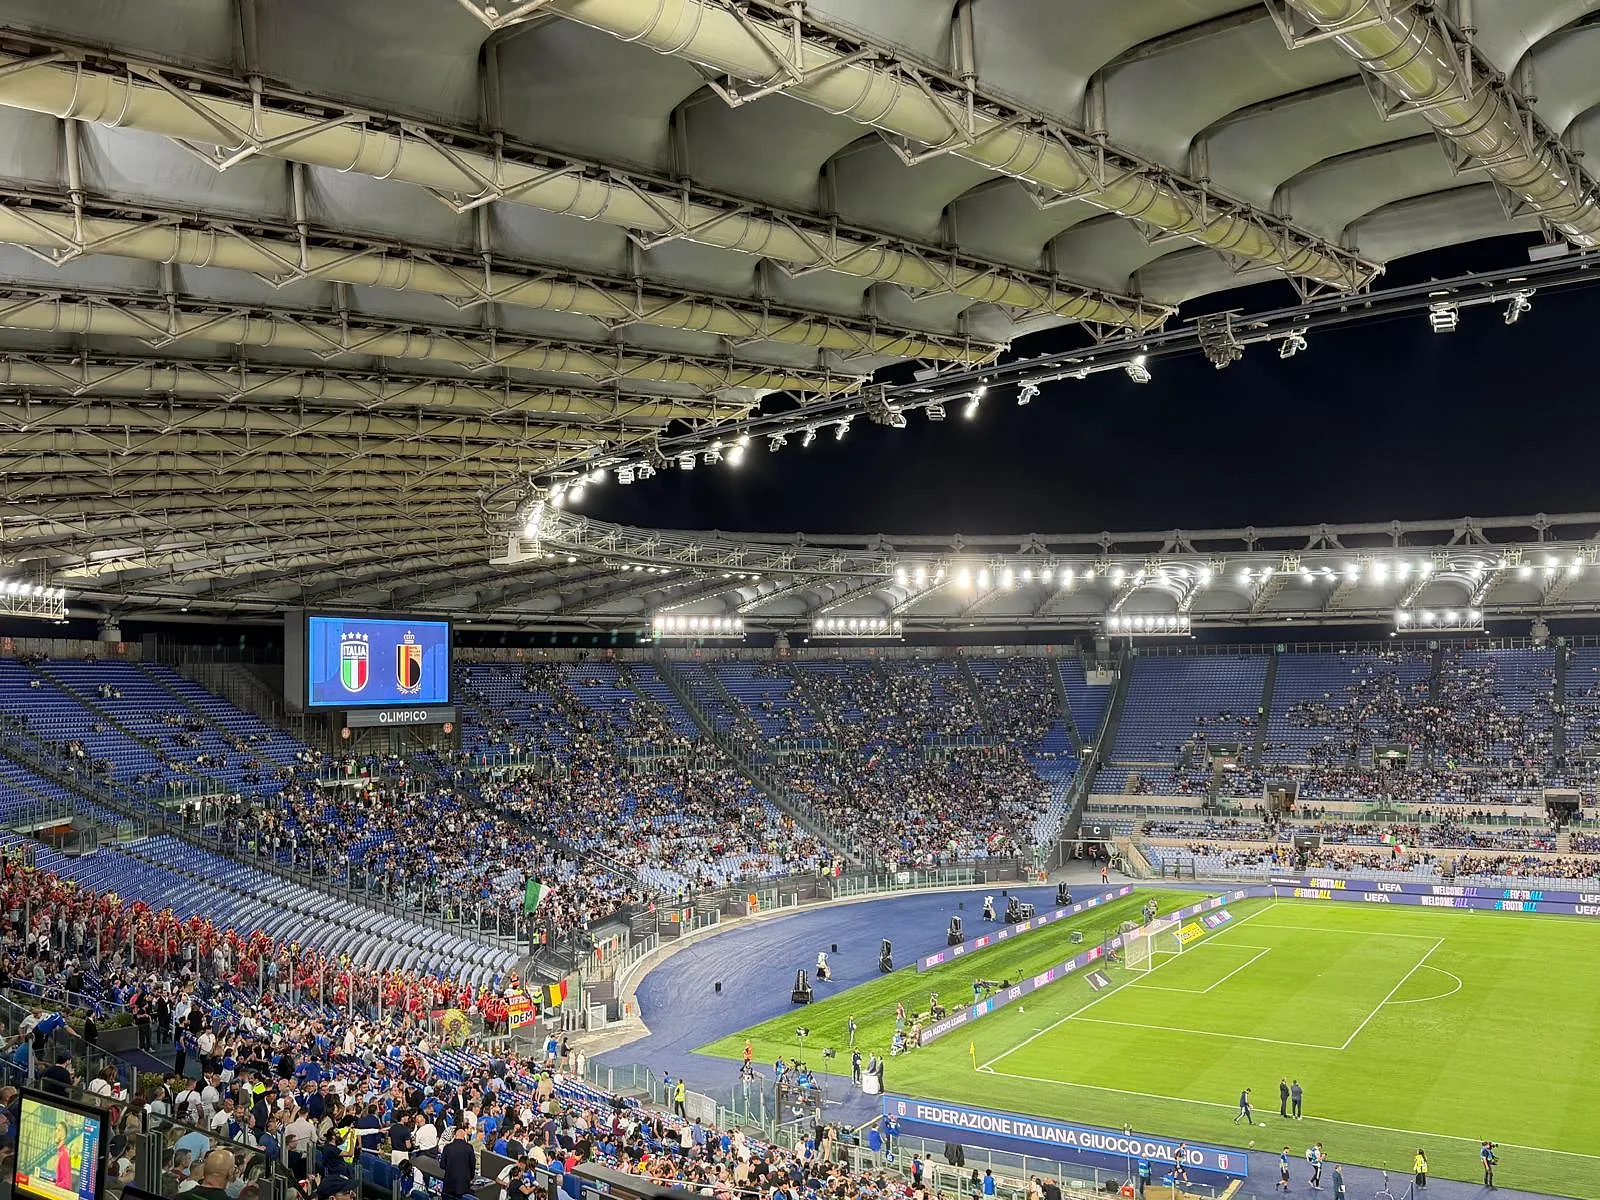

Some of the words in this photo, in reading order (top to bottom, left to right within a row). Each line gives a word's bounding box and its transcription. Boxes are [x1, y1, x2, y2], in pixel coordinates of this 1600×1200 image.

[344, 645, 366, 656] ITALIA
[379, 710, 427, 723] OLIMPICO
[1093, 826, 1101, 834] C
[1377, 882, 1402, 892] UEFA
[1432, 885, 1464, 896] WELCOME
[1294, 887, 1332, 900] #FOOTBALL
[1364, 892, 1390, 903] UEFA
[1421, 895, 1455, 907] WELCOME
[1494, 900, 1537, 912] #FOOTBALL
[917, 1105, 1010, 1134] FEDERAZIONE
[1013, 1122, 1077, 1145] ITALIANA
[1079, 1134, 1141, 1155] GIUOCO
